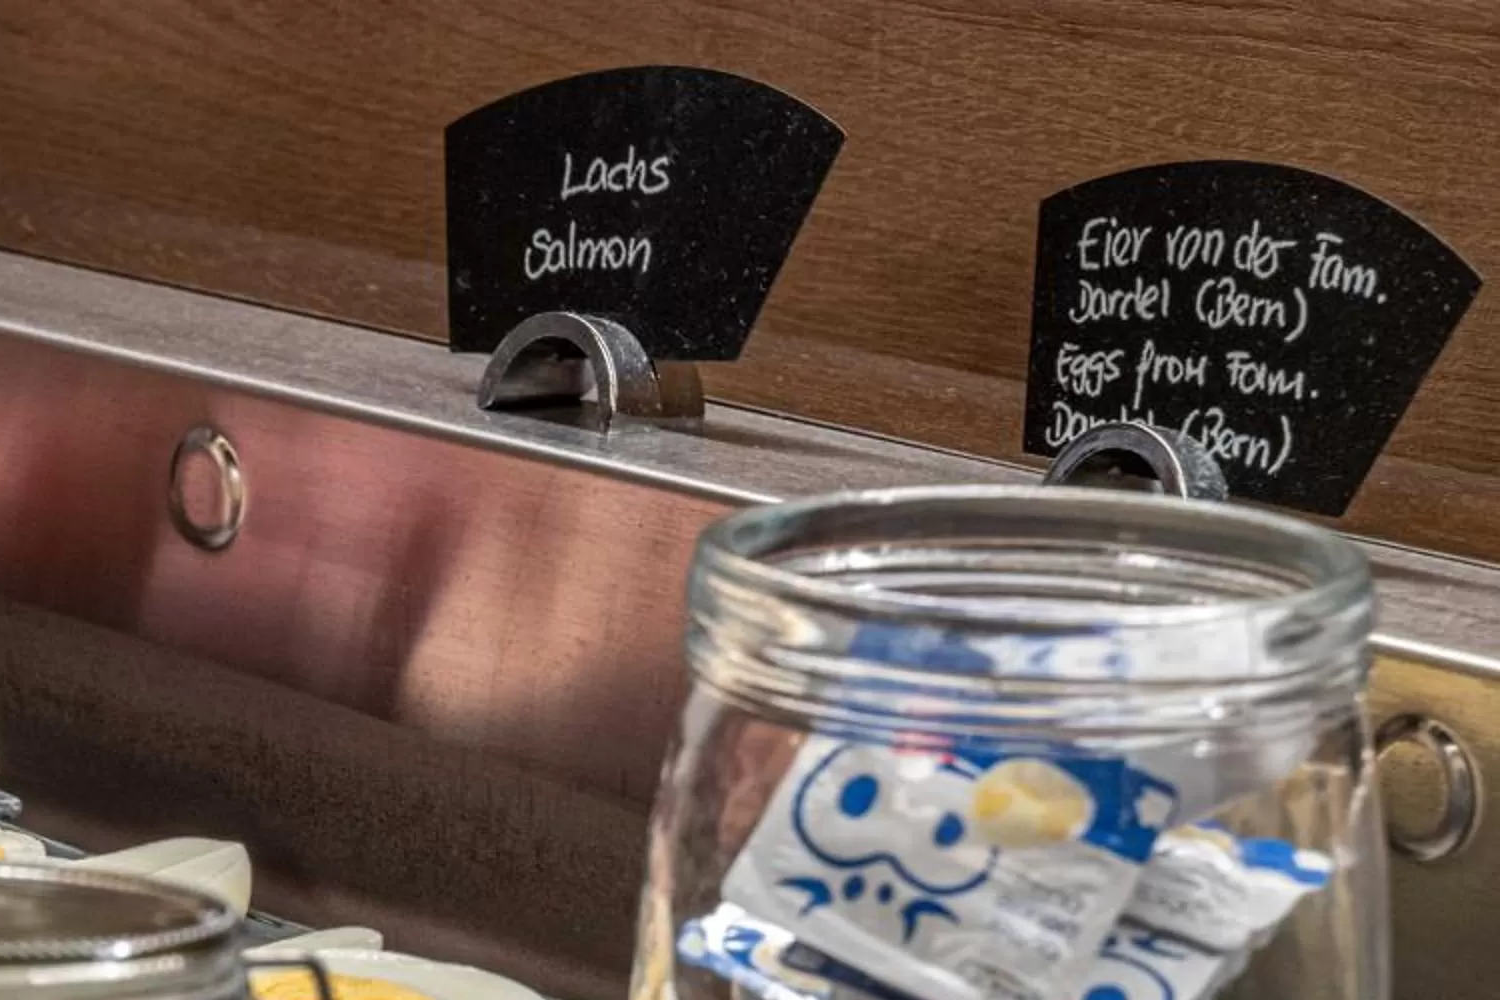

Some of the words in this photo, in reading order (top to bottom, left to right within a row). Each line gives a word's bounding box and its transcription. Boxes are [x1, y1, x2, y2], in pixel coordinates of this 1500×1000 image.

[561, 145, 670, 199] Lachs
[524, 221, 651, 279] Salmon
[1077, 216, 1152, 270] Eier
[1166, 225, 1225, 271] von
[1233, 219, 1298, 278] der
[1308, 232, 1387, 303] Fam.
[1069, 276, 1170, 324] Dardel
[1196, 276, 1307, 342] (Bern)
[1057, 341, 1124, 397] Eggs
[1133, 339, 1208, 411] from
